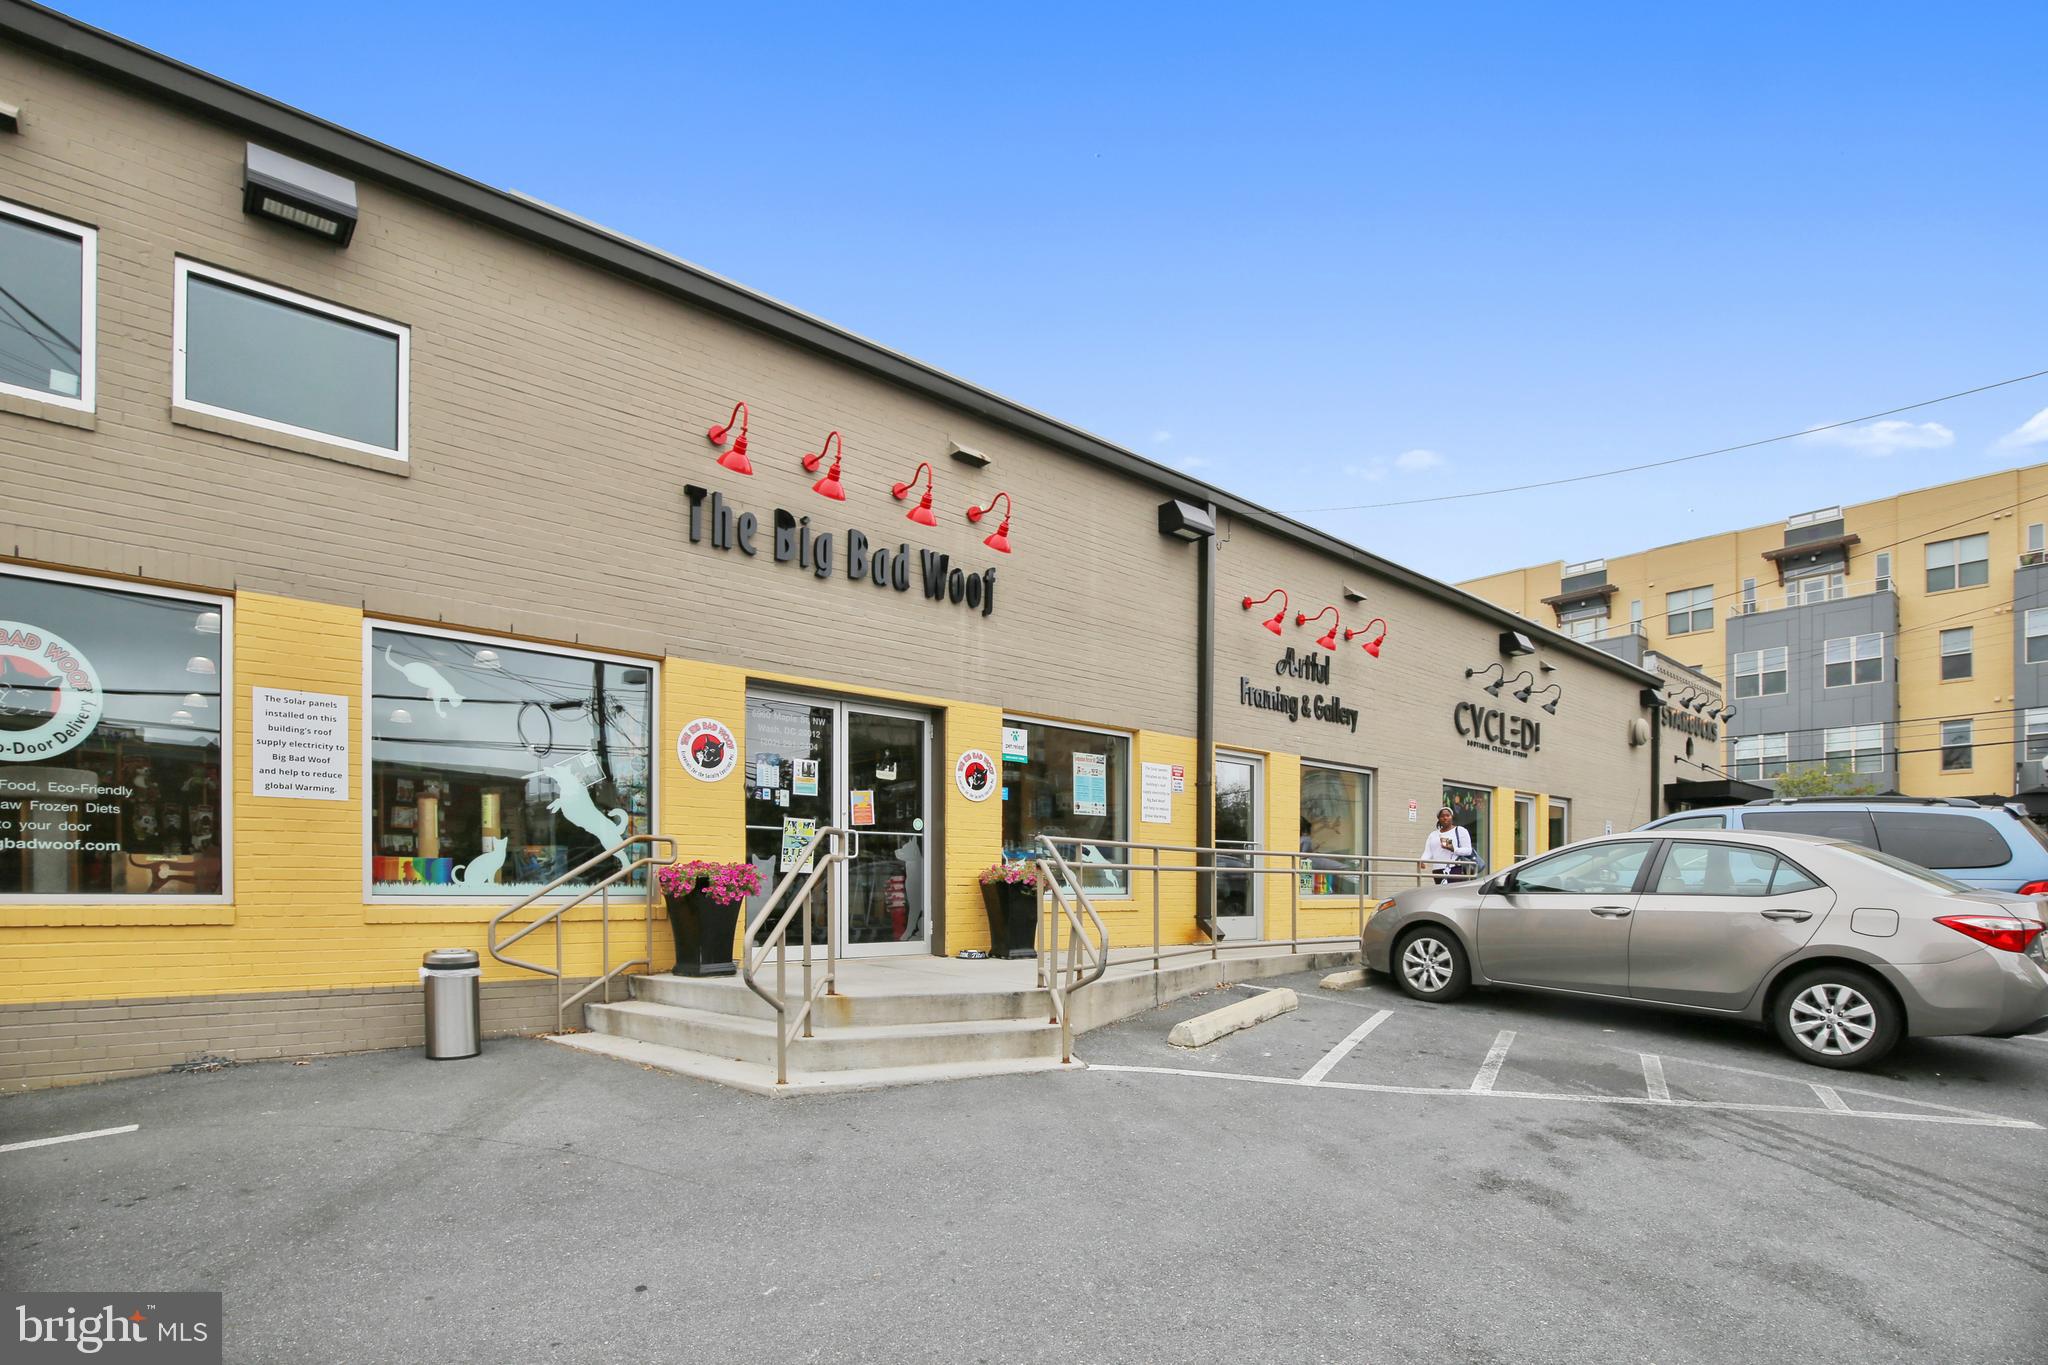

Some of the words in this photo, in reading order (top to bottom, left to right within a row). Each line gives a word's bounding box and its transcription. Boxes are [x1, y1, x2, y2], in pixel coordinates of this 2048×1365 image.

[683, 483, 758, 556] The
[774, 508, 833, 578] Big
[848, 528, 910, 592] Bad
[920, 549, 996, 617] Woof
[0, 628, 42, 651] BAD
[44, 642, 94, 694] WOOF
[1275, 647, 1330, 685] Artful
[264, 694, 282, 702] The
[283, 696, 306, 705] Solar
[308, 700, 338, 709] panels
[1240, 676, 1299, 722] Framing
[1301, 695, 1312, 718] &
[1313, 694, 1359, 733] Gallery
[52, 699, 97, 744] Delivery
[265, 709, 305, 719] installed
[320, 714, 337, 723] this
[812, 717, 827, 726] NW
[268, 724, 312, 735] building's
[1453, 701, 1541, 753] CYCLED!
[256, 739, 287, 748] supply
[289, 741, 334, 752] electricity
[272, 753, 286, 762] Big
[288, 754, 306, 762] Bad
[308, 756, 331, 764] Woof
[259, 767, 277, 775] and
[278, 768, 299, 777] help
[312, 771, 343, 779] reduce
[0, 779, 40, 792] Food,
[48, 781, 133, 798] Eco-Friendly
[264, 782, 293, 790] global
[295, 783, 337, 794] Warming.
[0, 801, 22, 810] aw
[30, 800, 78, 812] Frozen
[86, 802, 121, 814] Diets
[0, 820, 12, 829] o
[19, 821, 52, 832] your
[58, 821, 92, 832] door
